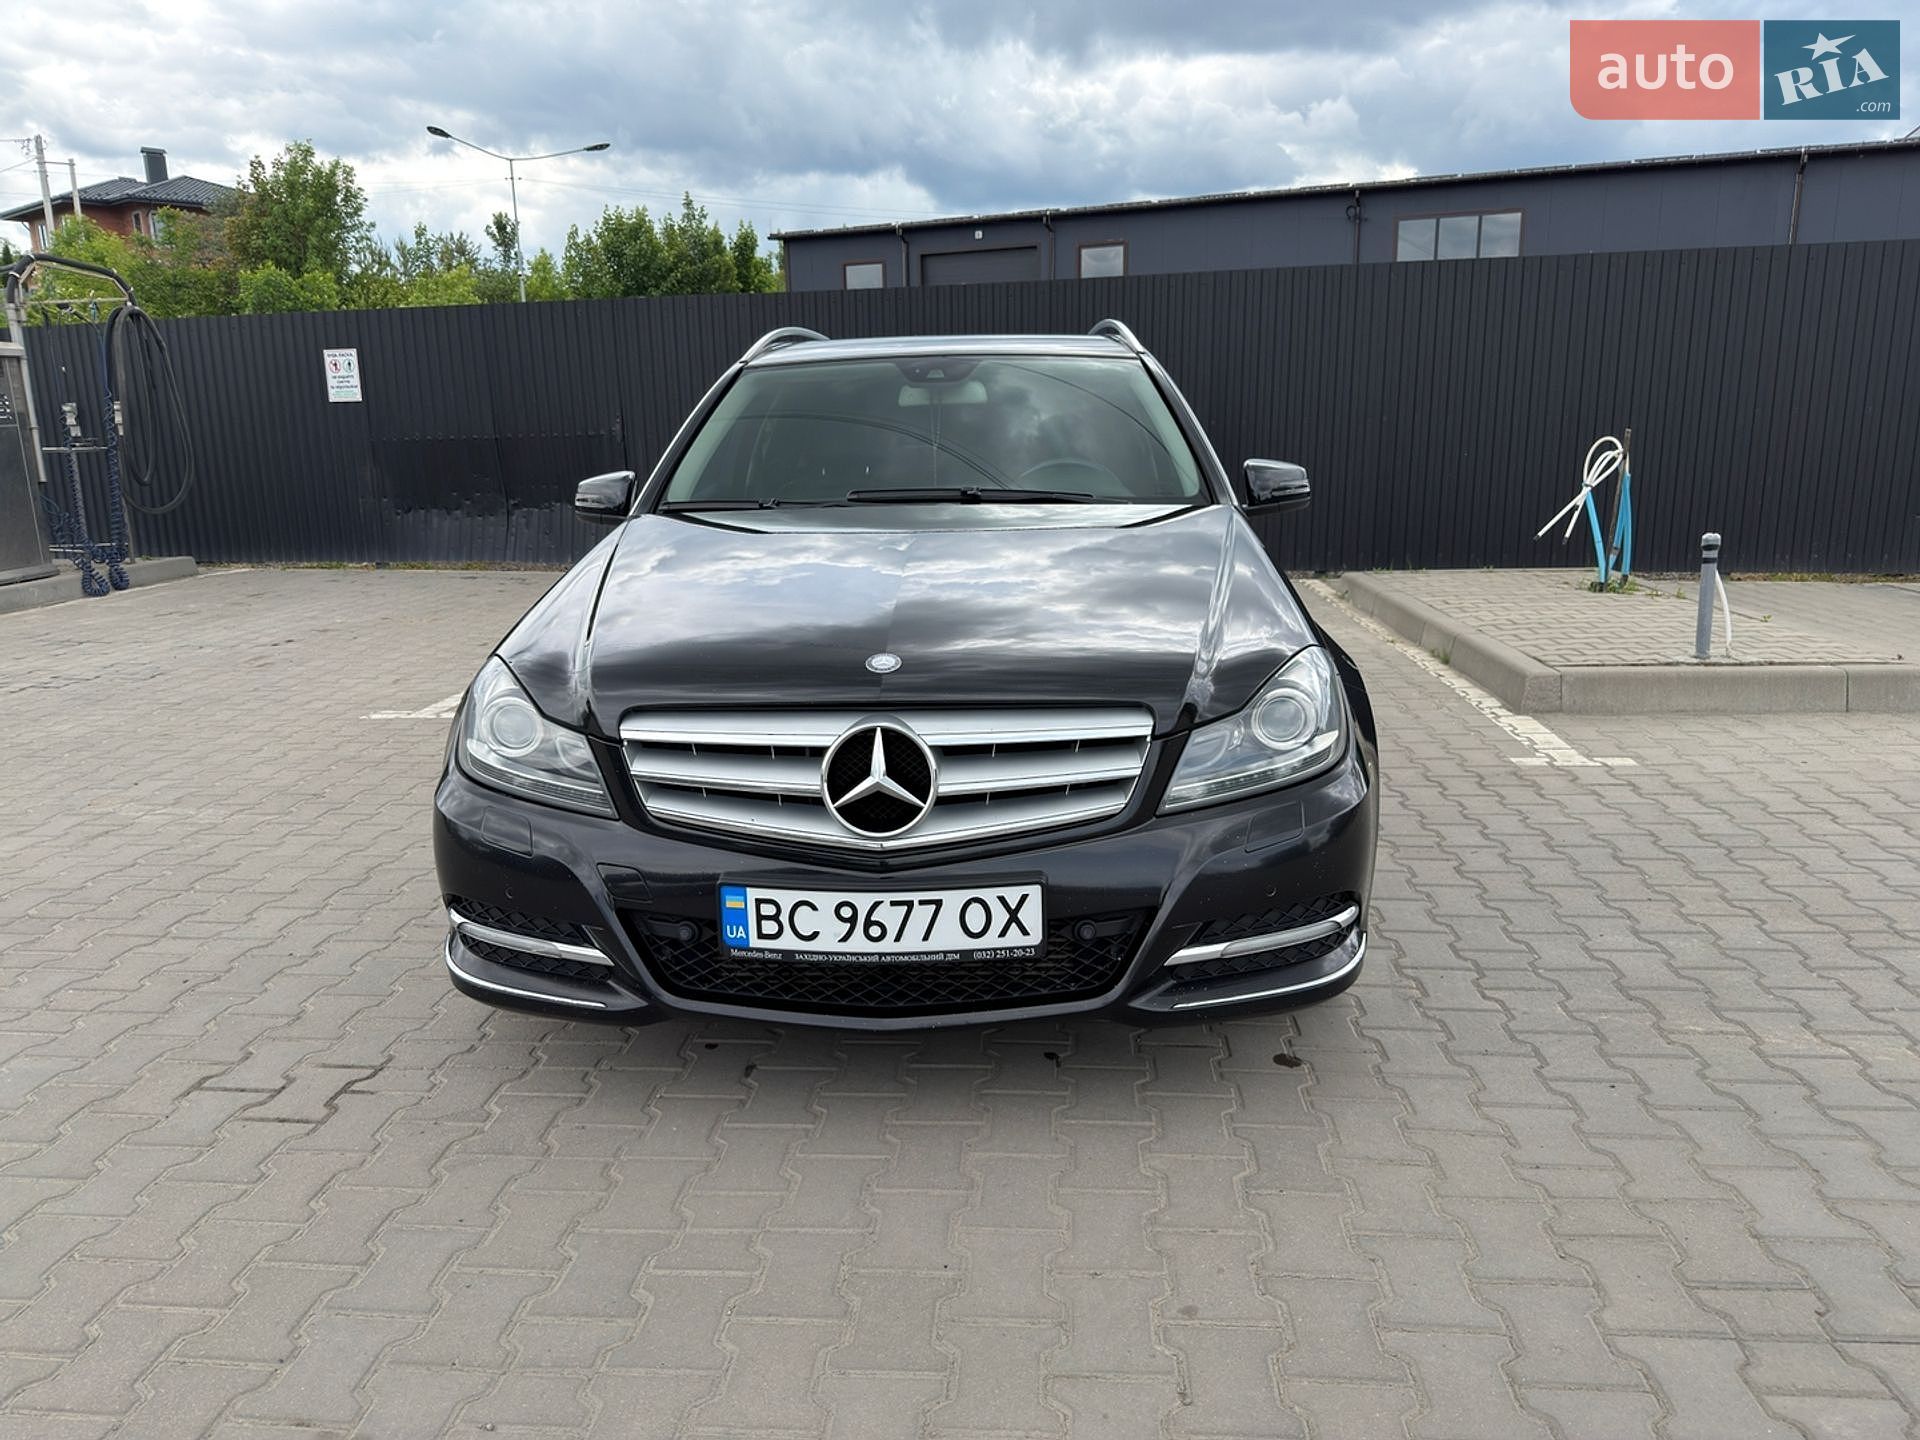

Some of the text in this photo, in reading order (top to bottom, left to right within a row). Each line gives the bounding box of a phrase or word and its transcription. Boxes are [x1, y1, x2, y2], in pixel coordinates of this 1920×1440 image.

[754, 893, 1031, 943] BC 9677 OX
[727, 925, 746, 939] UA
[730, 948, 783, 960] Mercedes-Benz
[973, 947, 1036, 960] (032) 251-20-23
